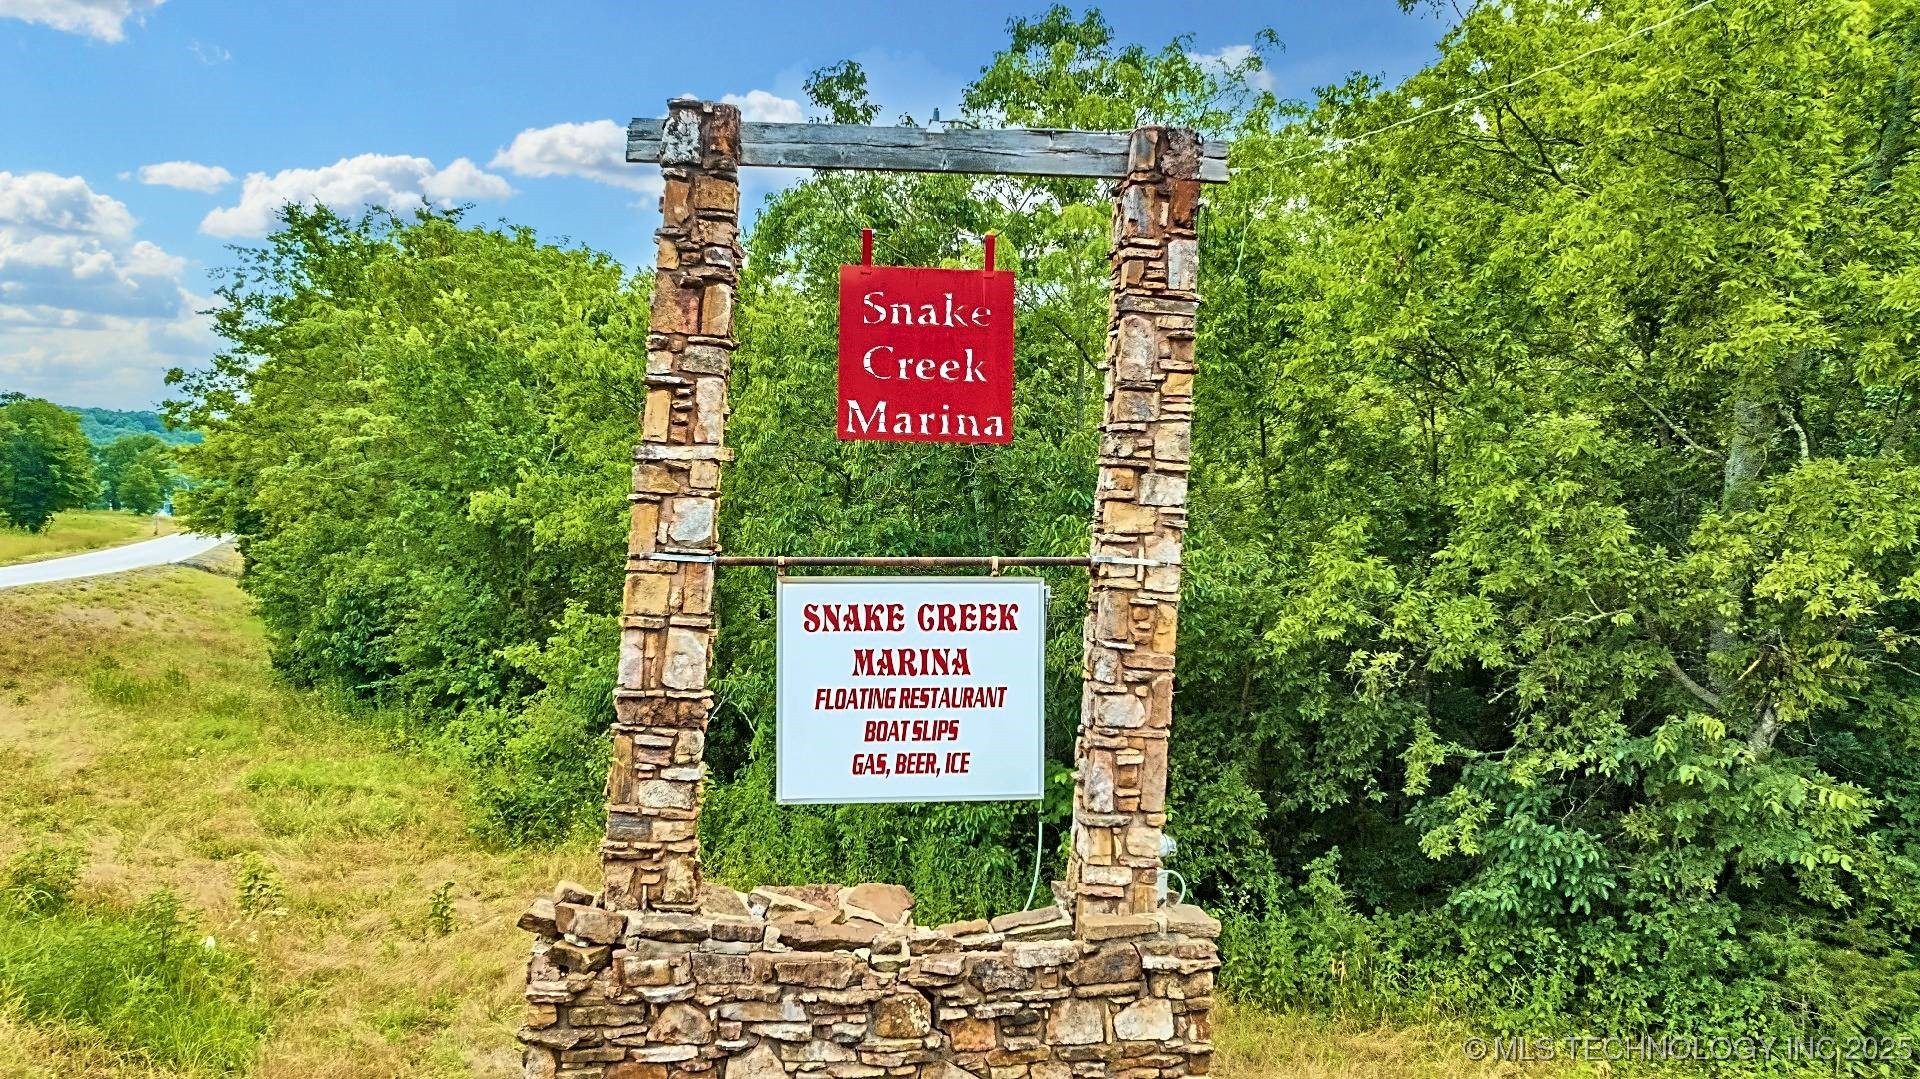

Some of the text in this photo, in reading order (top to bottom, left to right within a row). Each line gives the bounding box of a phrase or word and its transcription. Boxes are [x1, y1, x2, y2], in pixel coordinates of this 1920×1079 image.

[863, 291, 992, 327] Snake
[863, 345, 987, 382] Creek
[846, 399, 1004, 437] Marina
[803, 603, 1019, 632] SNAKE CREEK
[852, 648, 971, 677] MARINA
[815, 687, 1007, 710] FLOATING RESTAURANT
[864, 720, 959, 742] BOAT SLIPS
[852, 752, 970, 778] GAS, BEER, ICE
